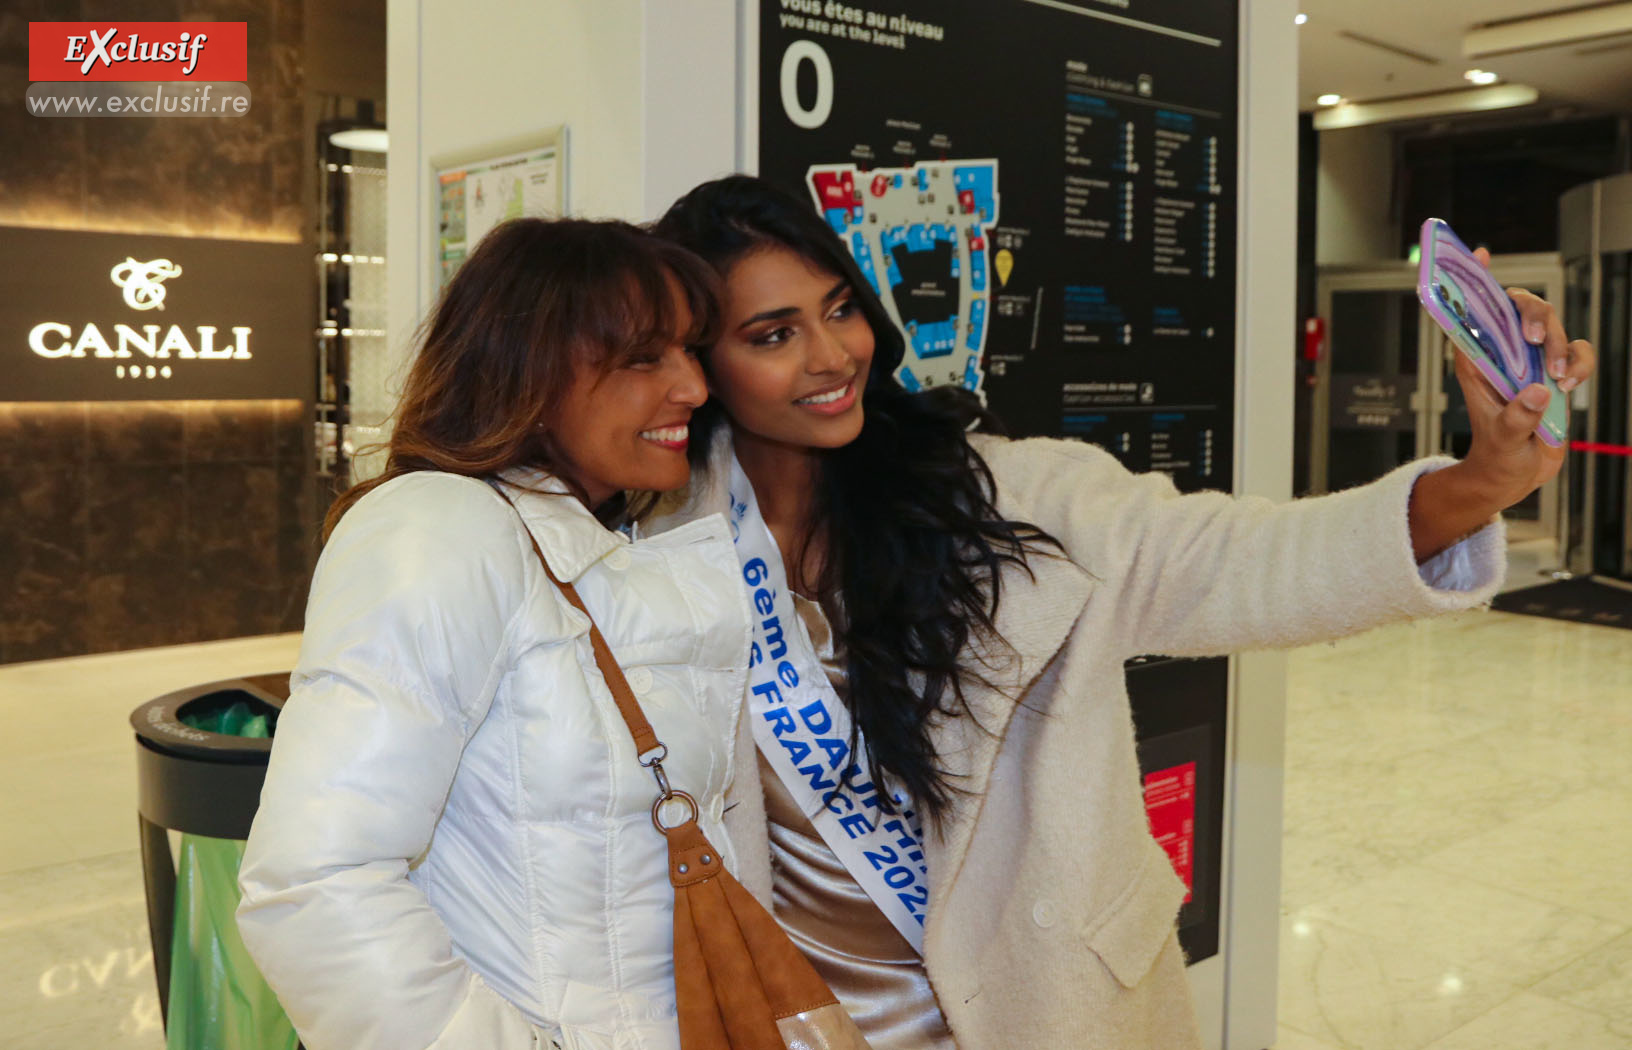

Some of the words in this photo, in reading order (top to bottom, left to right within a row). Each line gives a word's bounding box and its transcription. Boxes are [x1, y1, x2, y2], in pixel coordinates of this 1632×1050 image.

[779, 13, 804, 28] you
[806, 17, 830, 34] are
[831, 23, 847, 38] at
[848, 25, 871, 43] the
[873, 29, 905, 50] level
[824, 0, 863, 25] êtes
[866, 11, 887, 29] au
[889, 13, 944, 41] niveau
[780, 40, 834, 129] 0
[28, 322, 253, 360] CANALI
[742, 557, 800, 689] 6ème
[751, 680, 876, 840] FRANCE
[863, 845, 929, 928] 202
